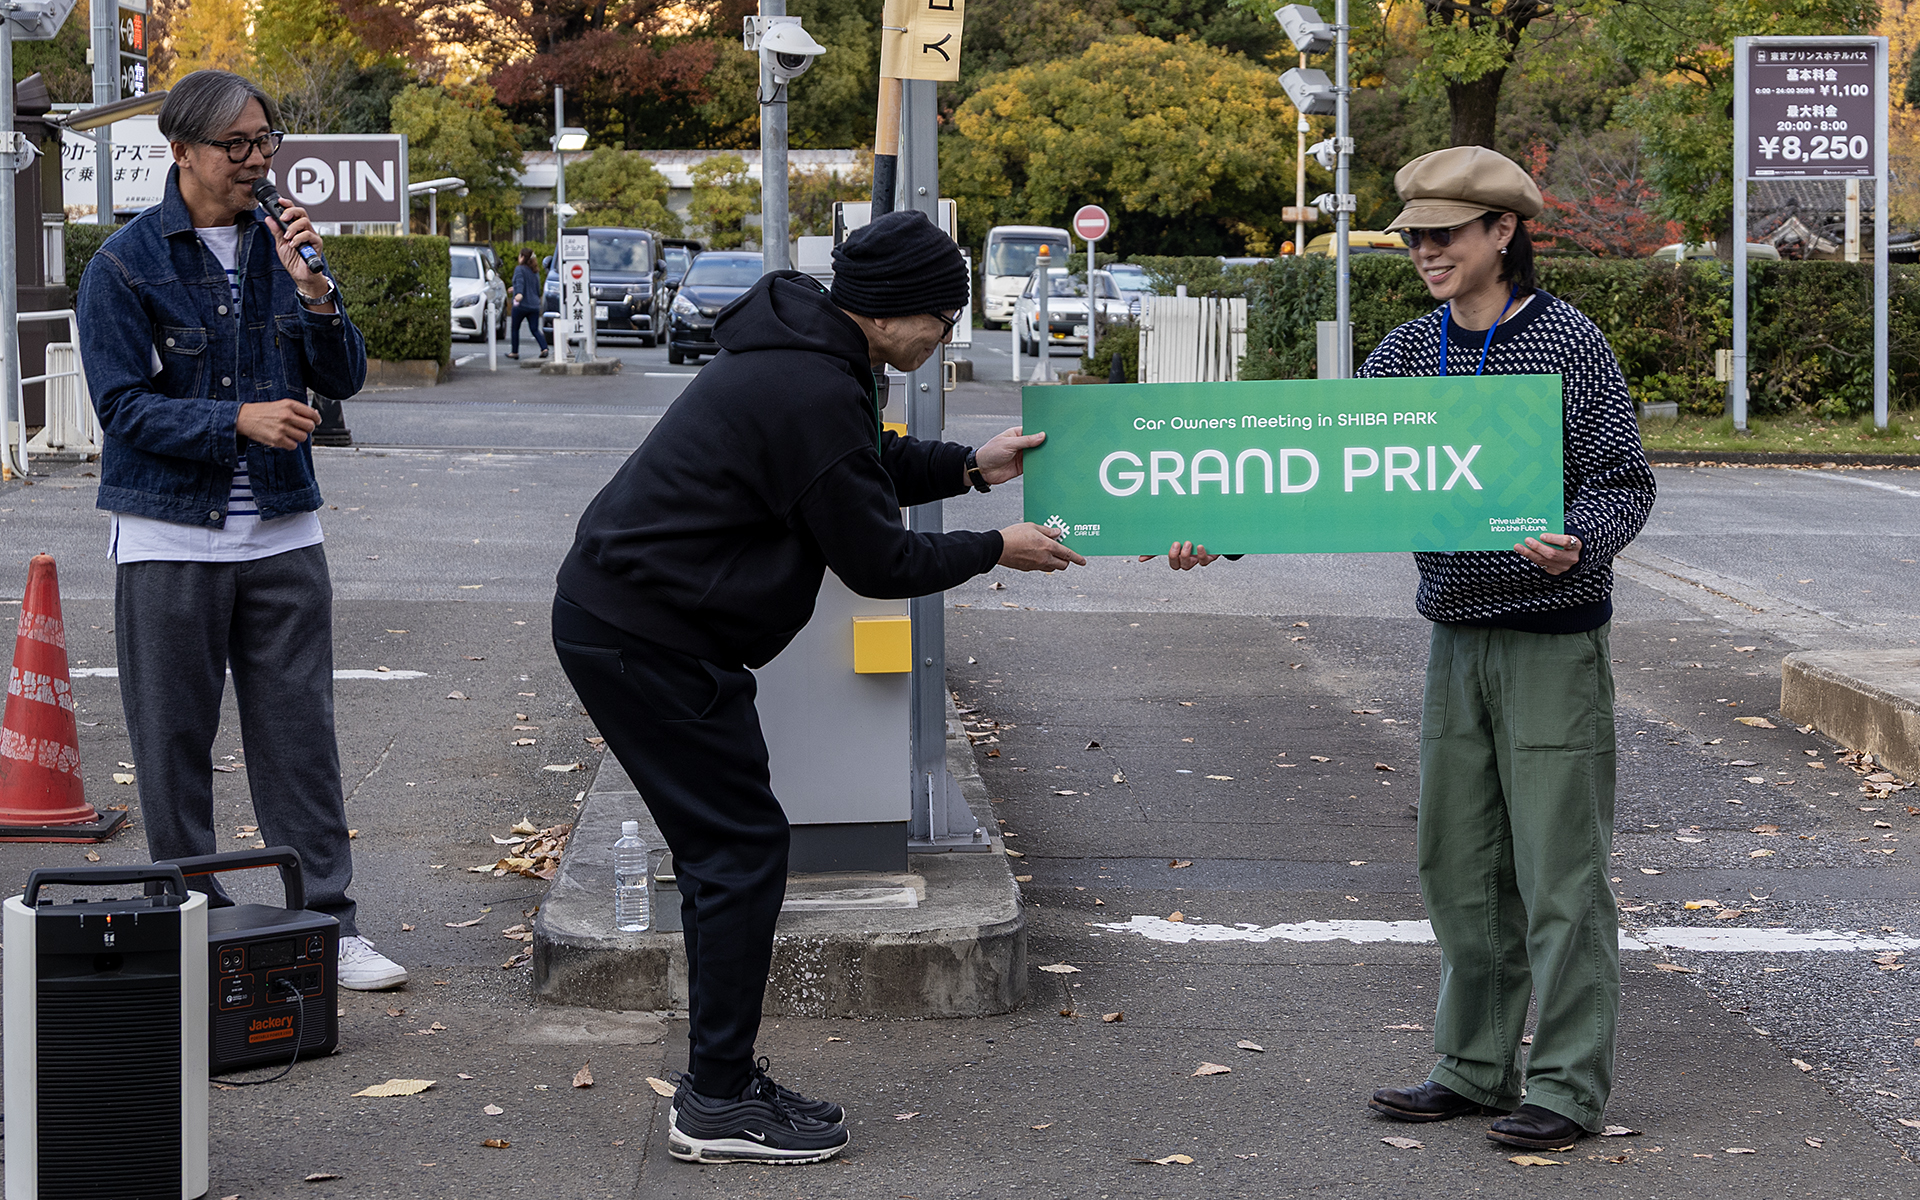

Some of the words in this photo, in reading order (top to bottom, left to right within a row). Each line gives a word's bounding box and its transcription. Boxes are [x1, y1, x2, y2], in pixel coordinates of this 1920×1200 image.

[1770, 52, 1868, 60] 東京プリンスホテルバス
[1786, 68, 1839, 81] 基本料金
[1755, 87, 1771, 95] 0:00
[1775, 87, 1795, 95] 24:00
[1819, 84, 1869, 97] ¥1,100
[1786, 104, 1839, 118] 最大料金
[1777, 121, 1812, 132] 20:00
[1820, 120, 1848, 131] 8:00
[1758, 135, 1869, 163] ¥8,250
[63, 167, 150, 182] で乗ます!
[338, 160, 395, 202] IN
[572, 281, 584, 334] 進入禁止
[1133, 417, 1166, 431] Car
[1170, 416, 1236, 430] Owners
[1241, 414, 1312, 431] Meeting
[1318, 413, 1333, 427] in
[1337, 413, 1388, 427] SHIBA
[1393, 411, 1438, 425] PARK
[1098, 448, 1320, 497] GRAND
[1343, 444, 1483, 493] PRIX
[1489, 517, 1508, 525] Drive
[1526, 517, 1548, 525] Care,
[1520, 524, 1548, 532] Future.
[249, 1015, 294, 1031] Jackery
